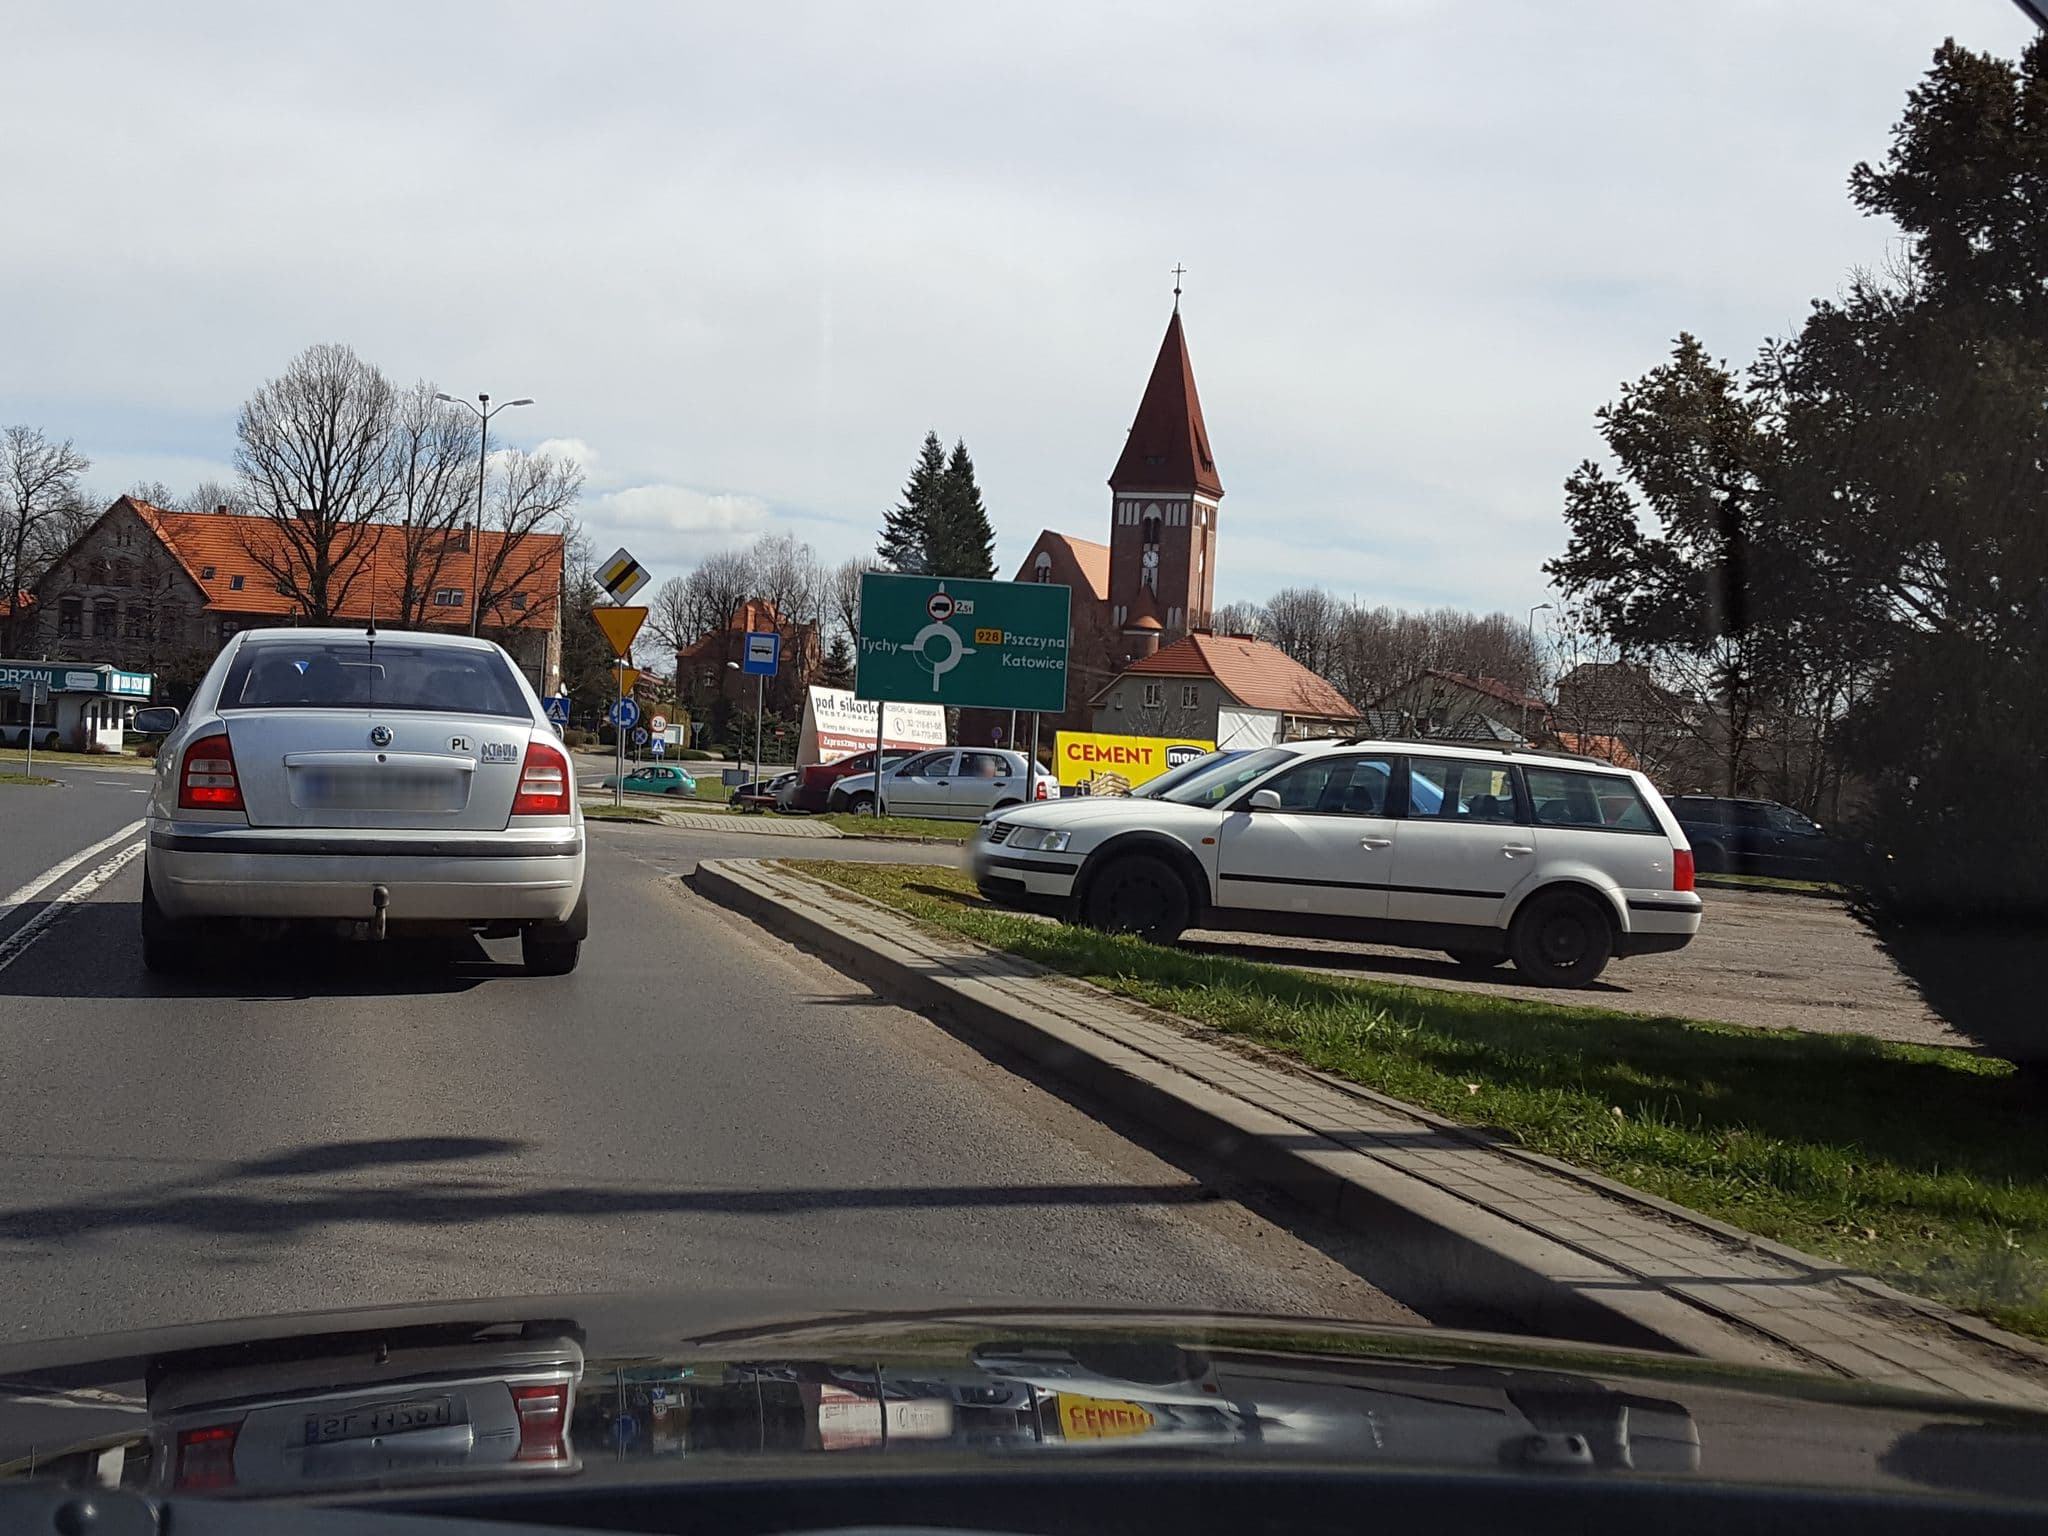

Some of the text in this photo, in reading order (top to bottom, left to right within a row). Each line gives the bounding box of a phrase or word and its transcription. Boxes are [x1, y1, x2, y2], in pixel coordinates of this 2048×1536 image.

[860, 636, 899, 656] Tychy
[977, 631, 1066, 650] 928 Pszczyna
[1002, 654, 1065, 670] Katowice
[815, 695, 834, 712] pod
[452, 738, 470, 751] PL
[1066, 743, 1153, 766] CEMENT
